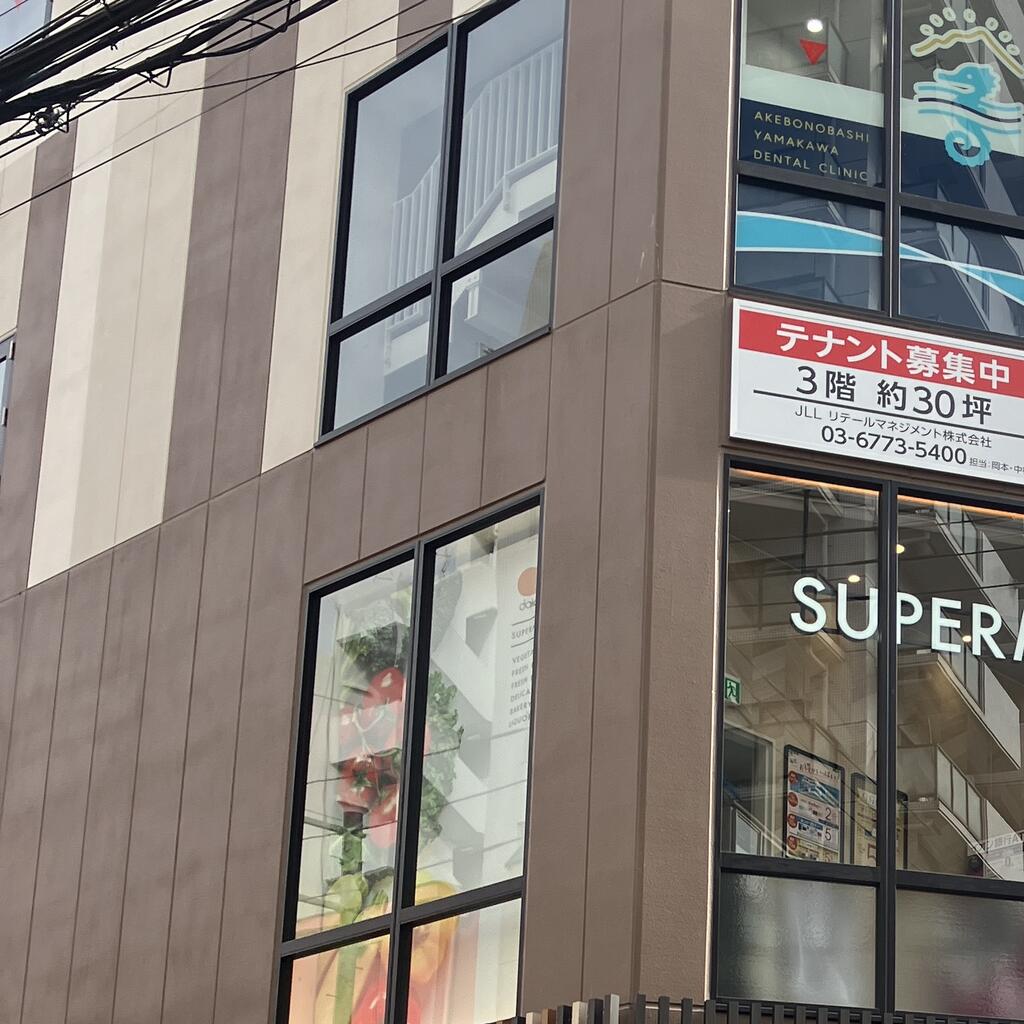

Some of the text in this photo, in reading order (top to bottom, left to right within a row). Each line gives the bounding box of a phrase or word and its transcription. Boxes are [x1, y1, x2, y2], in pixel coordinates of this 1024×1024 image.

[754, 111, 870, 143] AKEBONOBASHI
[754, 131, 839, 156] YAMAKAWA
[753, 149, 870, 183] DENTAL CLINIC
[776, 322, 1010, 389] テナント募集中
[796, 366, 992, 425] 3階 約30坪
[795, 405, 992, 448] JLL リテールマネジメント株式会社
[821, 425, 967, 465] 03-6773-5400
